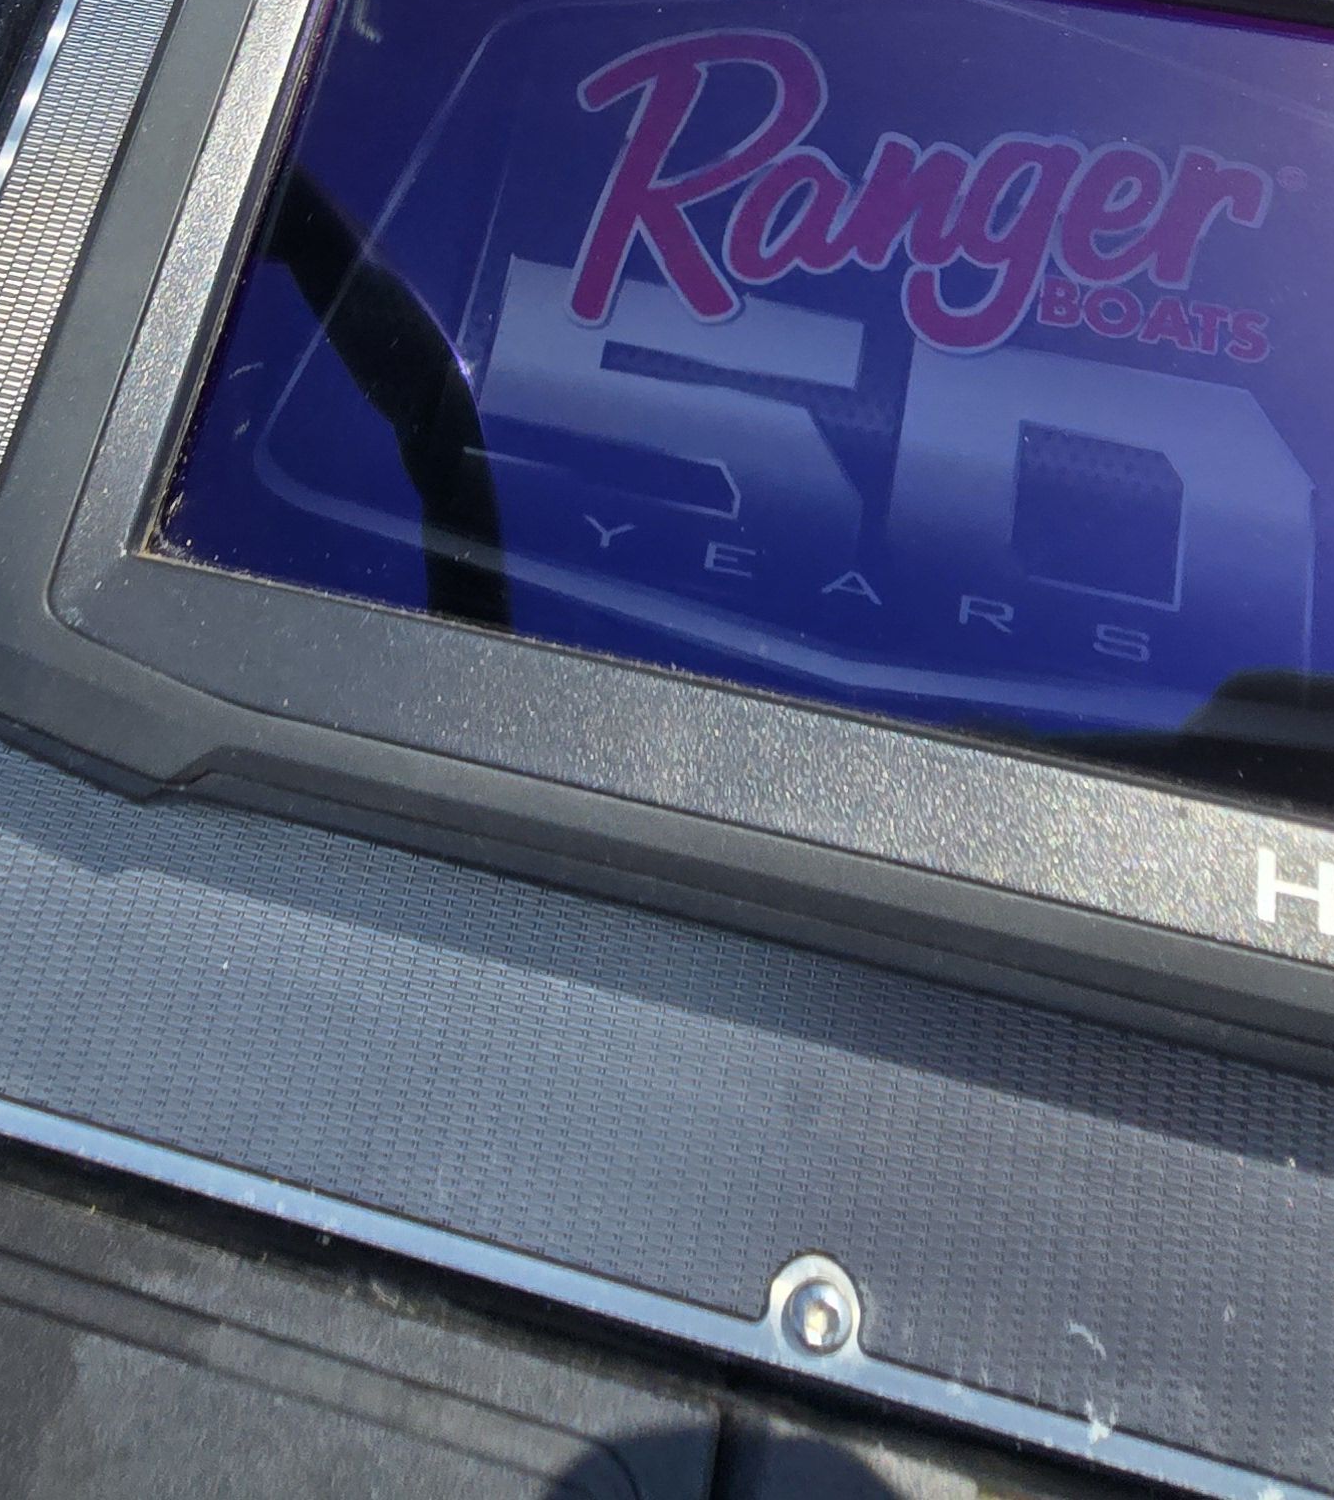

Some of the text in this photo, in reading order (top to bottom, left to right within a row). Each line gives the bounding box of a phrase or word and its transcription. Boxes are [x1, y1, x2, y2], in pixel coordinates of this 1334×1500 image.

[565, 28, 1272, 353] Ranger
[1037, 275, 1271, 363] BOATS
[584, 514, 1151, 663] YEARS
